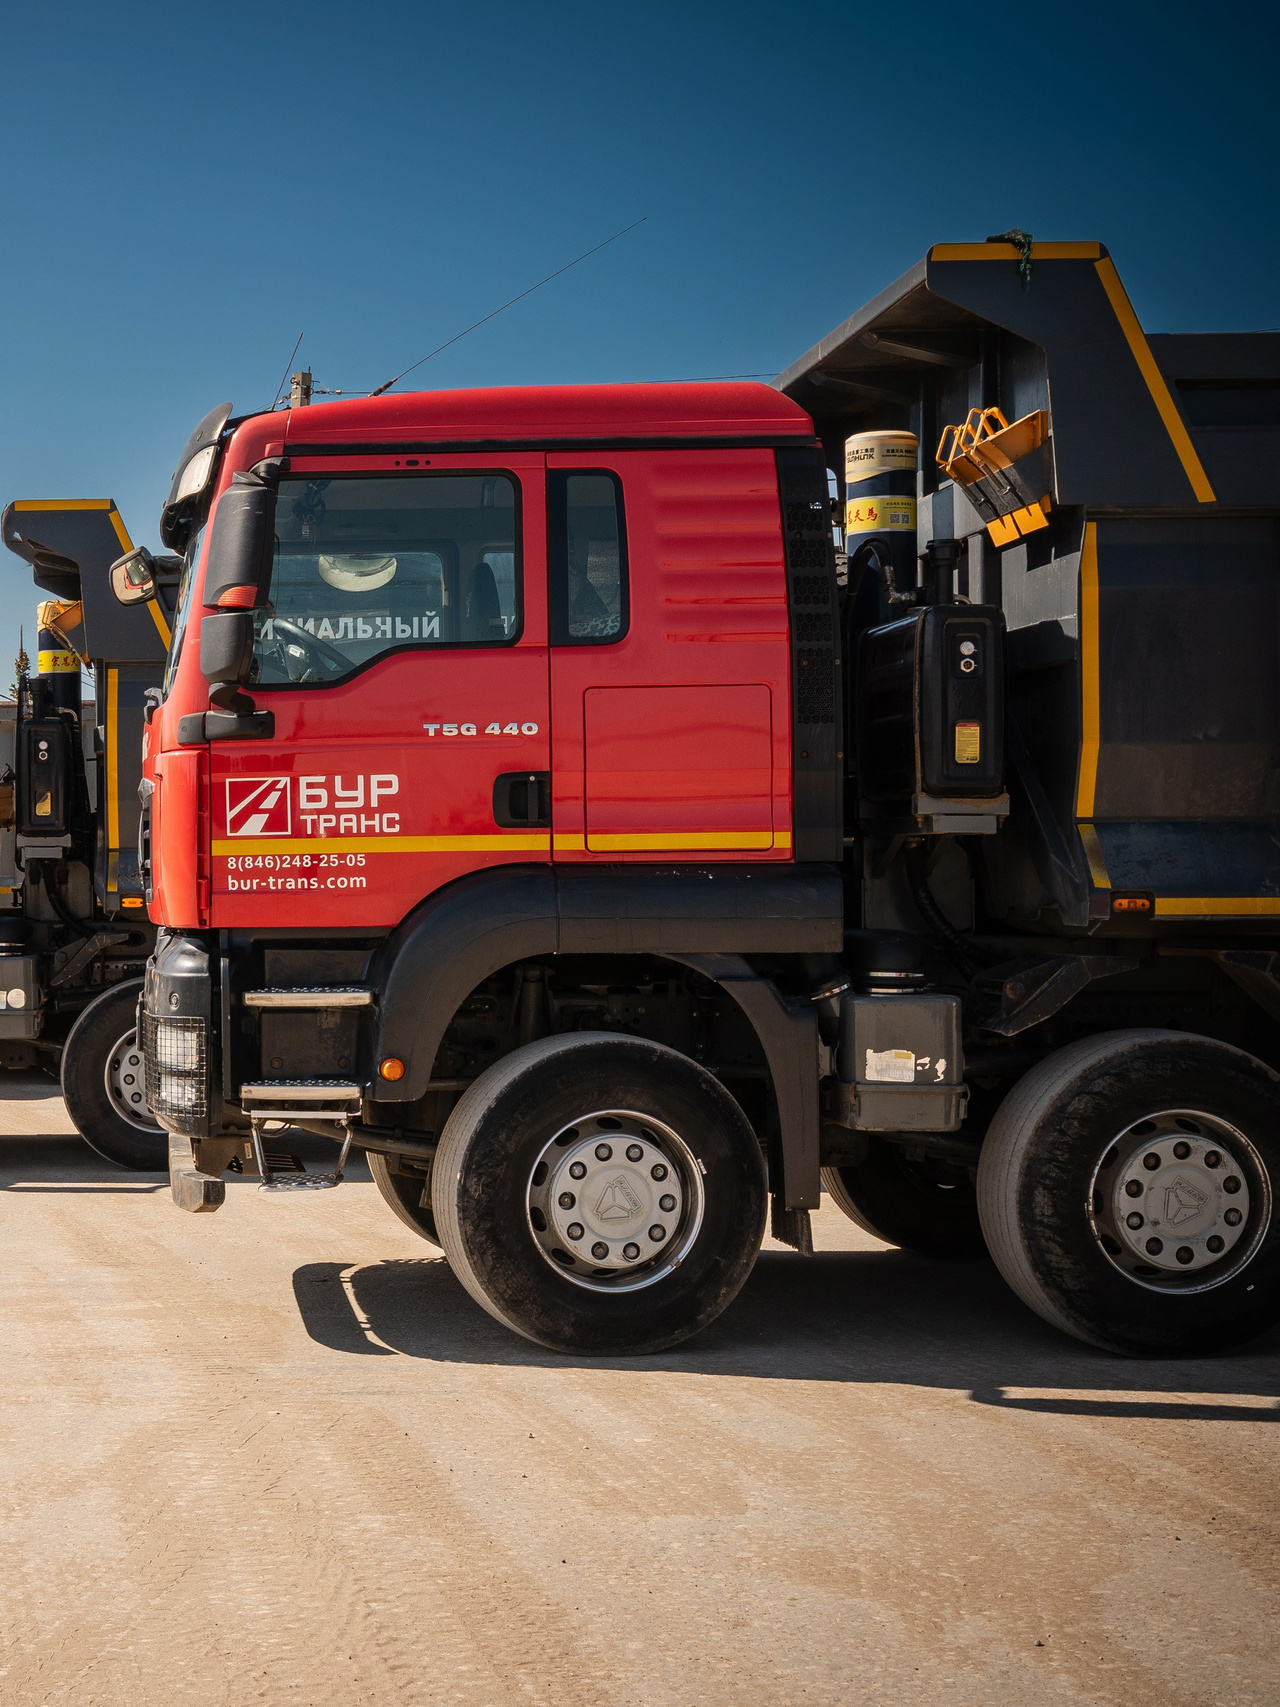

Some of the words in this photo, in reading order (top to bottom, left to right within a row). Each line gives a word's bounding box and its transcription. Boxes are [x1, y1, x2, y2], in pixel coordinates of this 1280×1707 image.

[423, 722, 477, 737] T5G
[484, 721, 539, 736] 440
[299, 774, 399, 809] БУР
[299, 812, 400, 835] ТРАНС
[227, 853, 366, 872] 8(846)248-25-05
[227, 874, 367, 891] bur-trans.com
